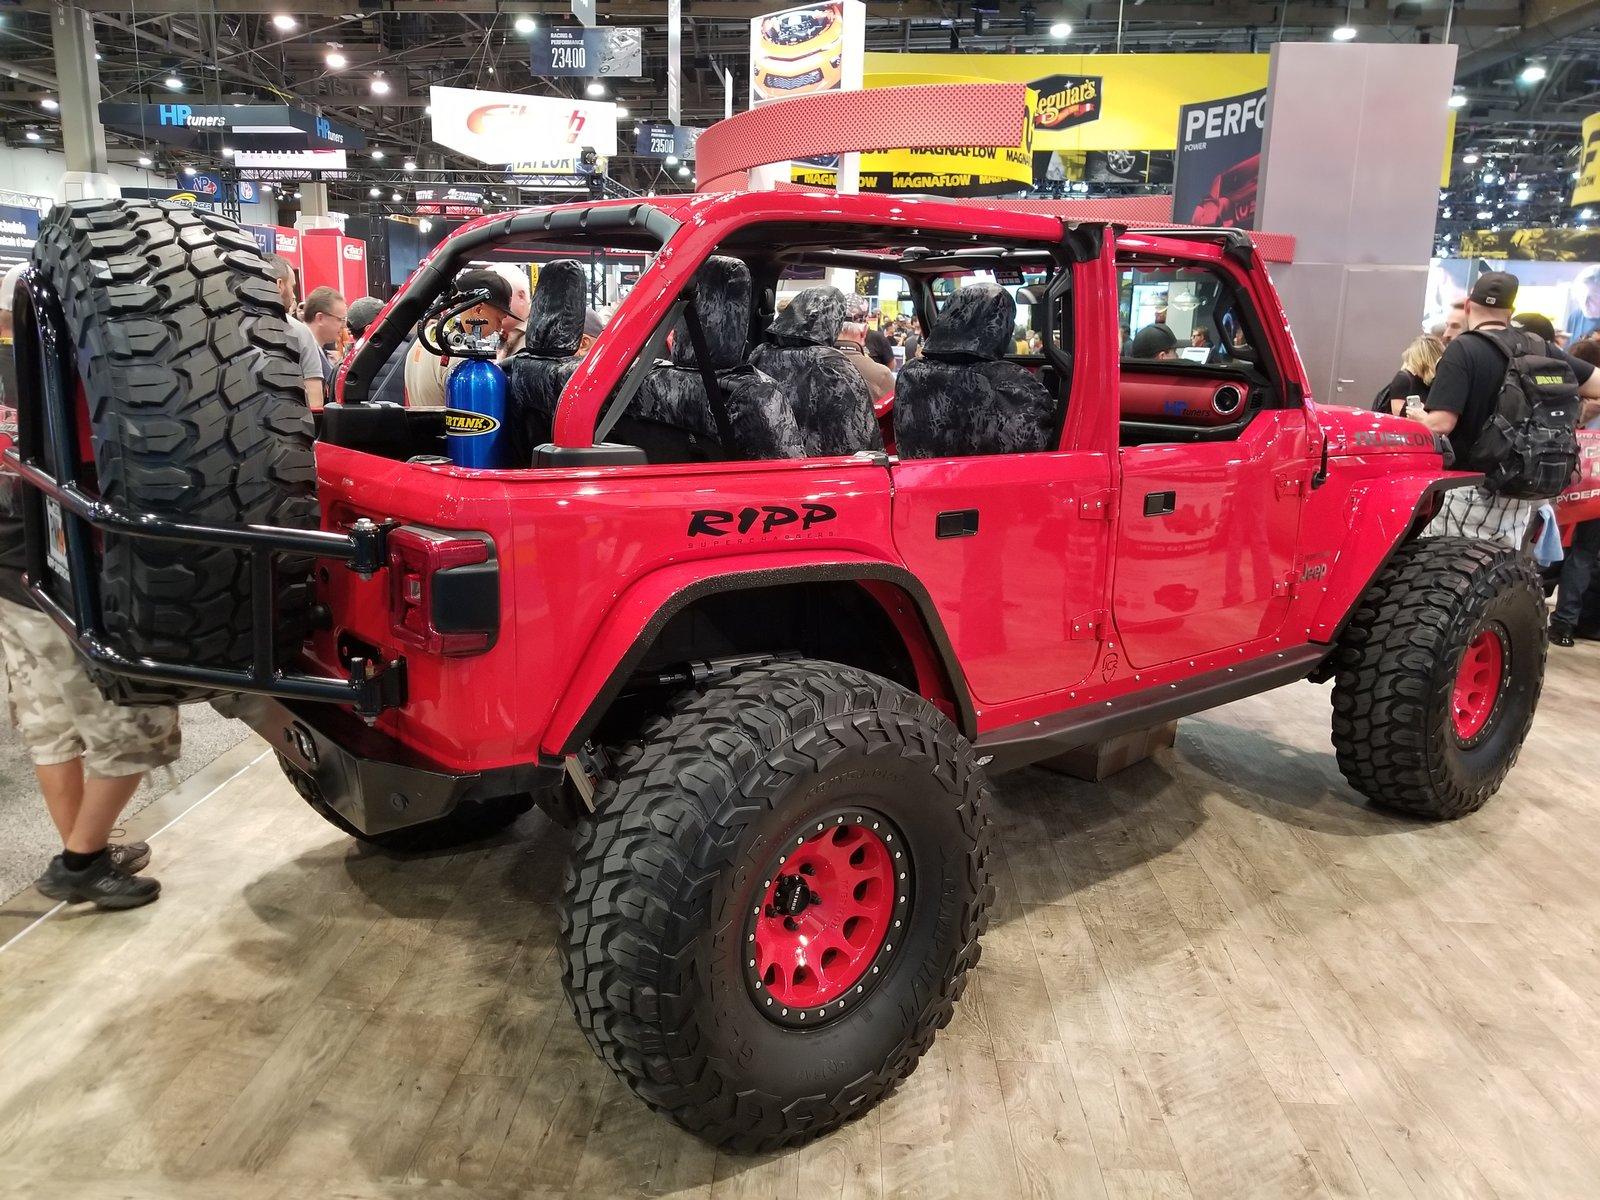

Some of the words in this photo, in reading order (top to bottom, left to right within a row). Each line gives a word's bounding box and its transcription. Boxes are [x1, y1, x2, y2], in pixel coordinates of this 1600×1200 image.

[551, 48, 586, 68] 23400
[160, 105, 189, 126] HP
[187, 114, 225, 127] tuners
[316, 117, 330, 139] HP
[650, 138, 674, 153] 23500
[1184, 142, 1207, 152] POWER
[892, 175, 972, 188] MAGNAFLOW
[1164, 400, 1188, 416] HP
[687, 503, 838, 538] RIPP
[1299, 563, 1327, 582] Jeep
